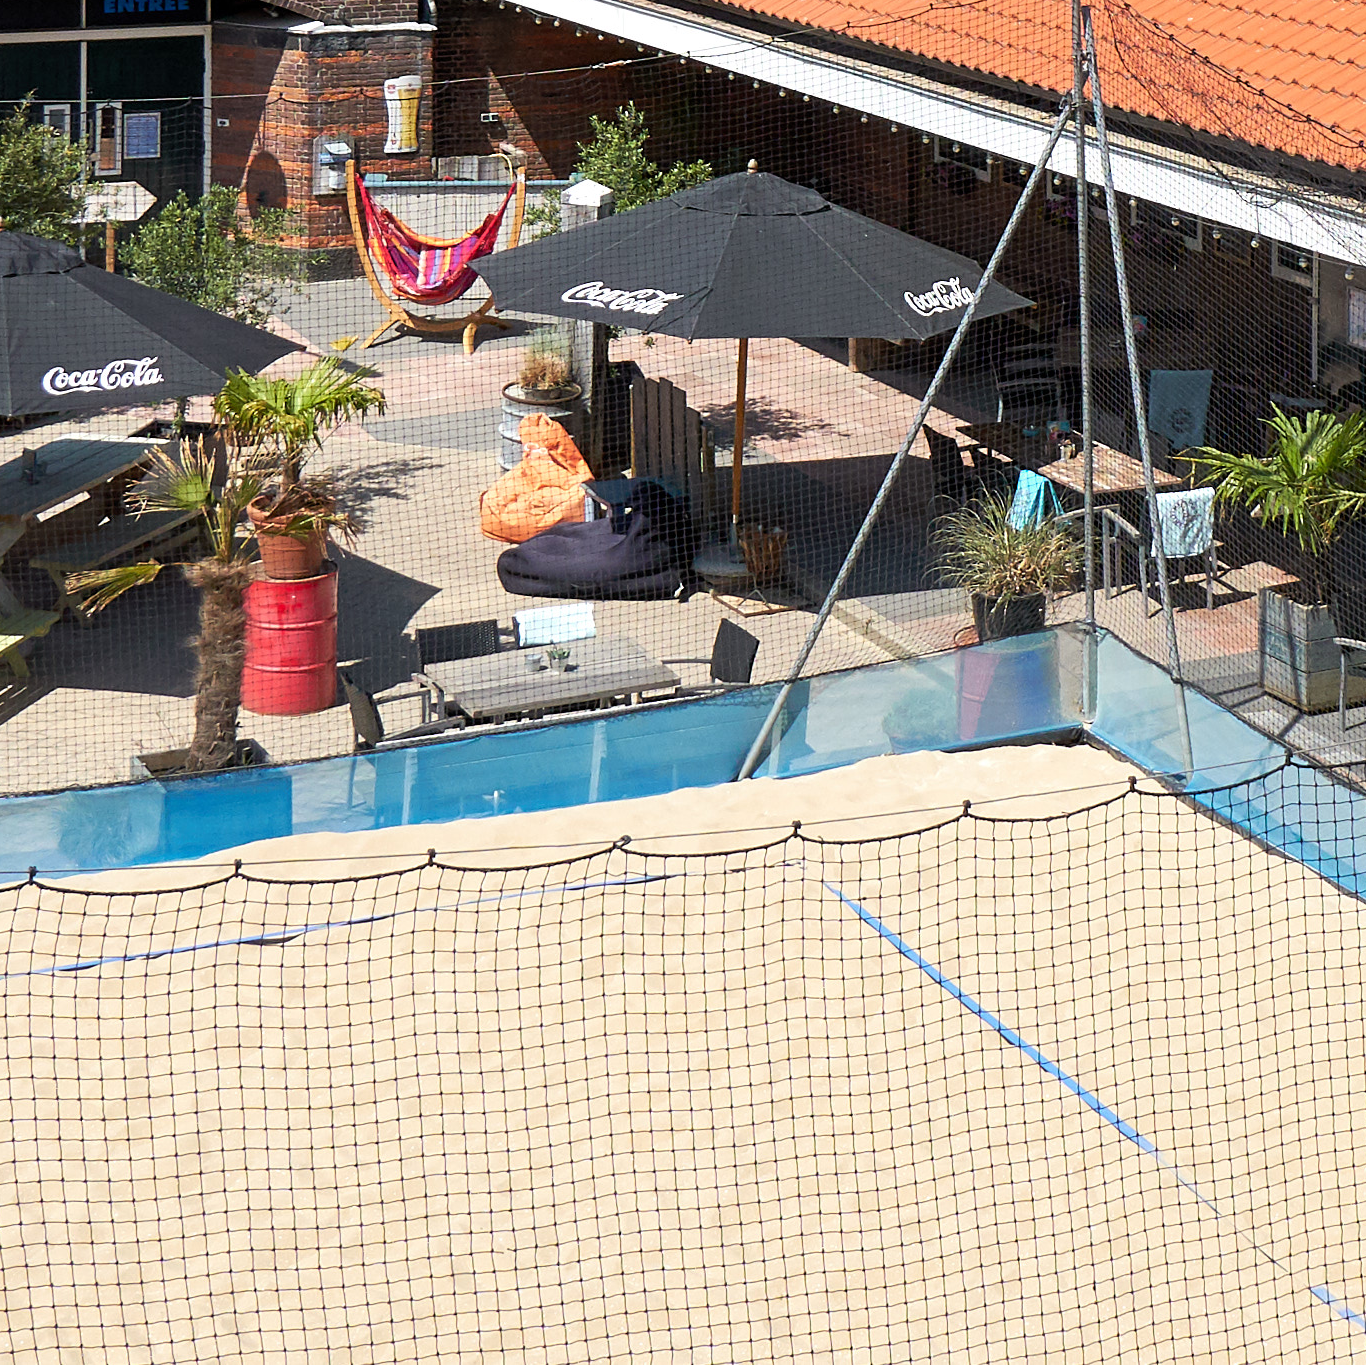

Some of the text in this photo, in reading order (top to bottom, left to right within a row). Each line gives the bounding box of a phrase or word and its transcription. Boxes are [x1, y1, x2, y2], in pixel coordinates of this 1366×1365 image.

[561, 281, 685, 315] Coca-Cola
[904, 277, 975, 317] Coca-Cola
[42, 356, 165, 396] Coca-Cola
